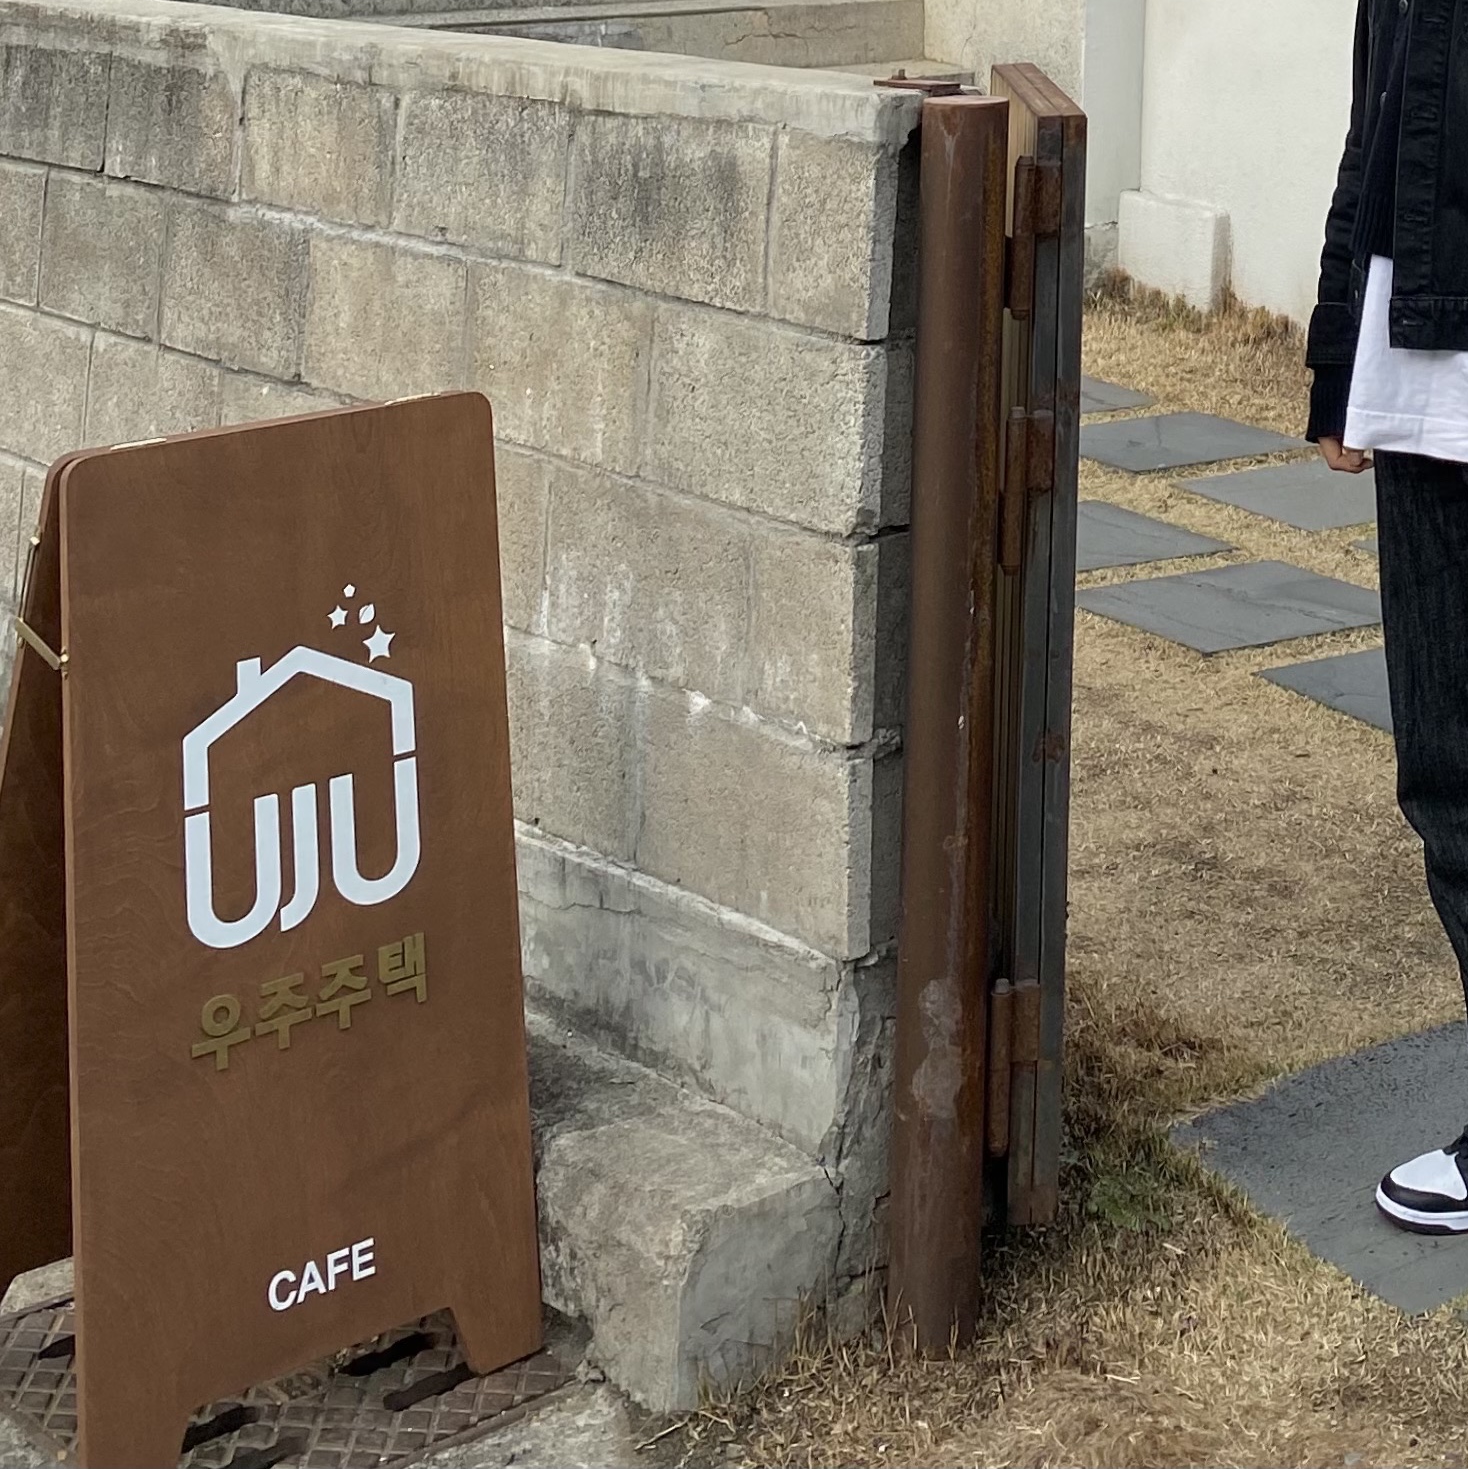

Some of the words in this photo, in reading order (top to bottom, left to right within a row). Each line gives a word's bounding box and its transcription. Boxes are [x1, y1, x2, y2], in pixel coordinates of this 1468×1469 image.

[184, 756, 421, 949] UJU
[190, 931, 428, 1072] 우주주택
[268, 1237, 376, 1311] CAFE
